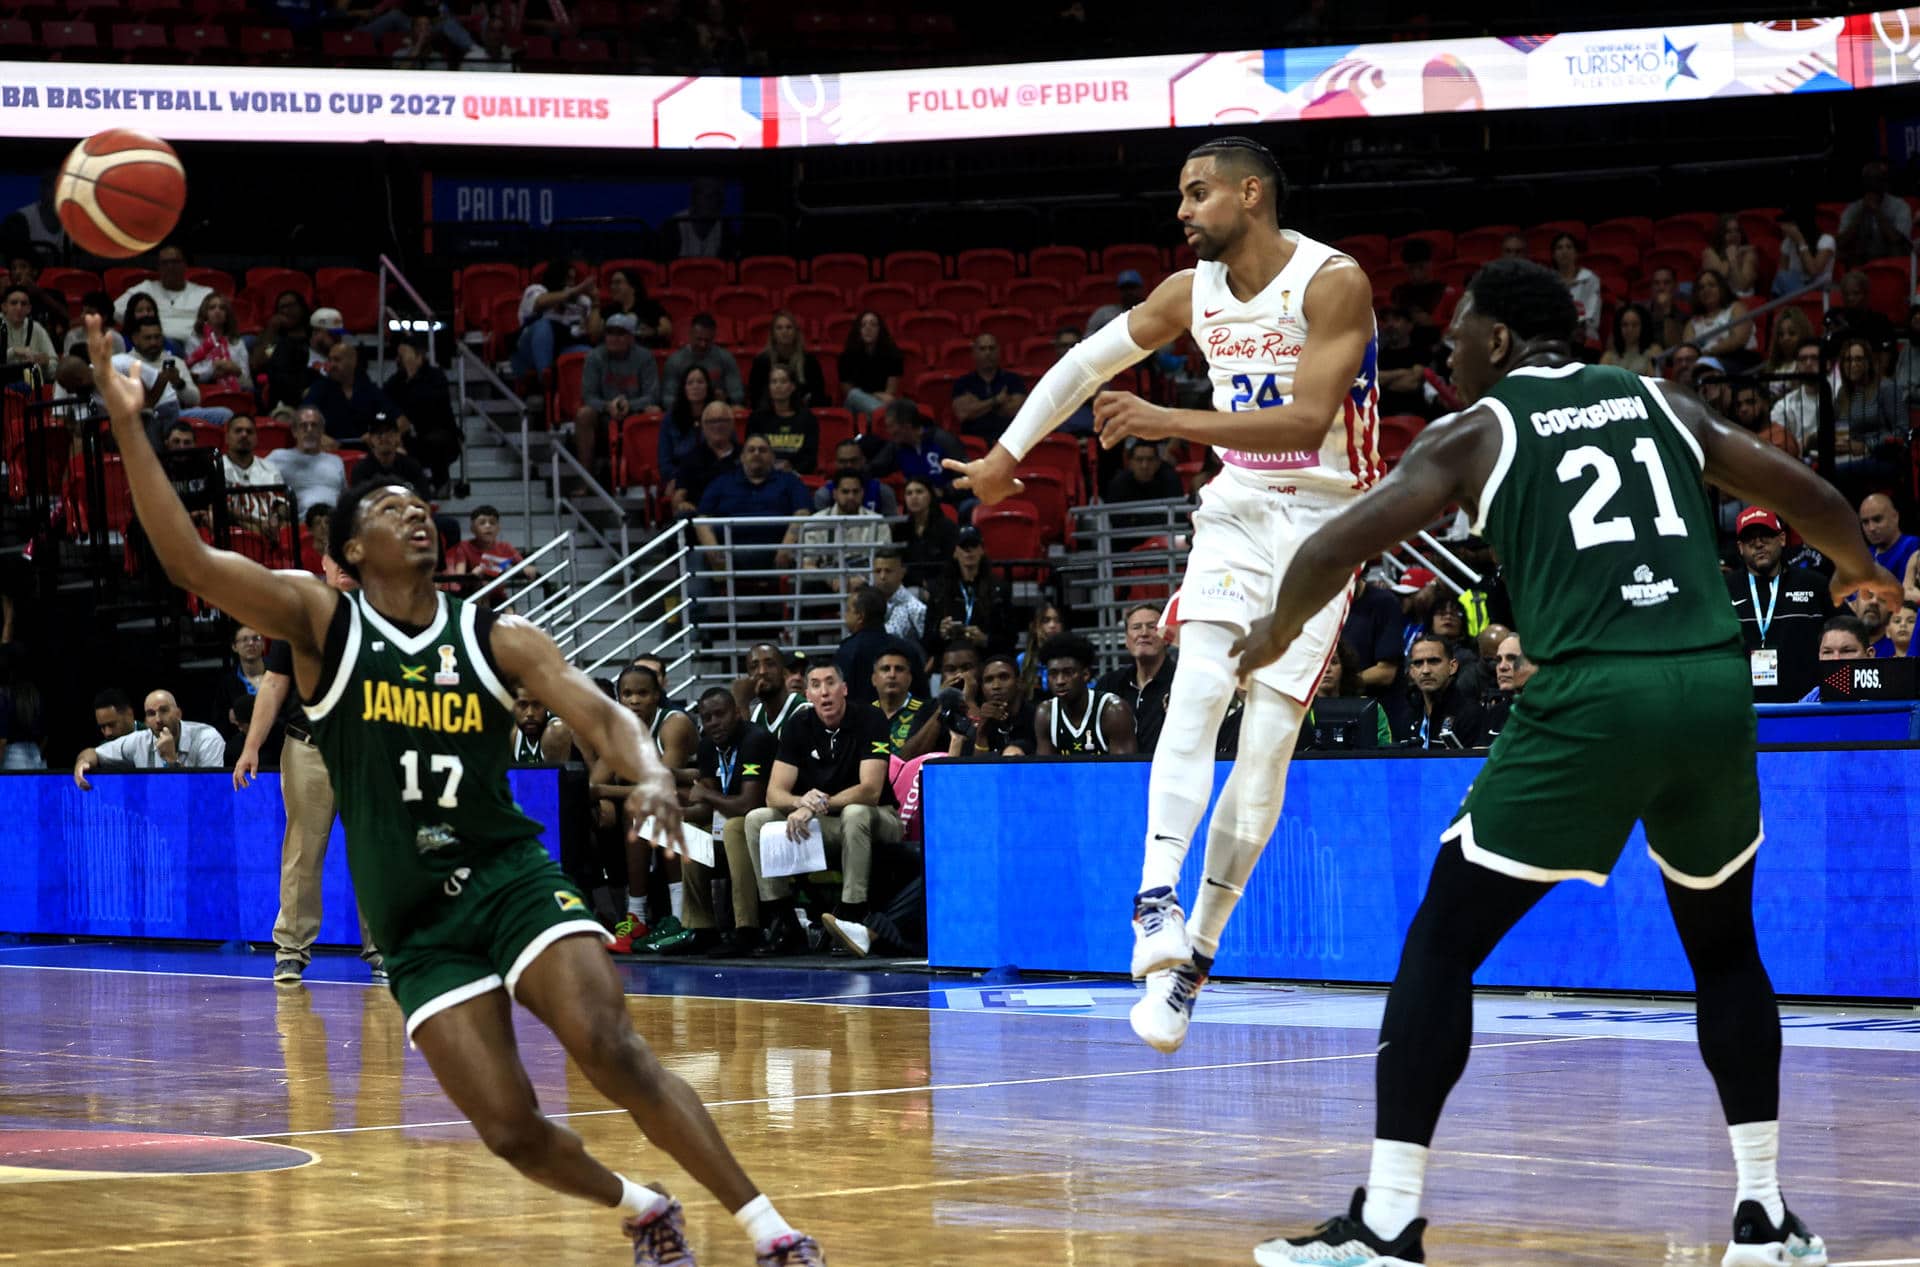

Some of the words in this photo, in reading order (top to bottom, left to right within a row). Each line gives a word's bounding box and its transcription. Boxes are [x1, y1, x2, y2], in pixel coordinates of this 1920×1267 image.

[1565, 52, 1660, 75] TURISMO
[46, 87, 222, 111] BASKETBALL
[230, 91, 321, 113] WORLD
[329, 93, 382, 115] CUP
[390, 95, 455, 116] 2027
[463, 96, 609, 120] QUALIFIERS
[908, 88, 1008, 112] FOLLOW
[1016, 80, 1129, 106] @FBPUR
[1208, 328, 1257, 360] Puerto
[1261, 333, 1302, 364] Rico
[1231, 374, 1284, 412] 24
[1530, 396, 1648, 437] COCKBURN
[1556, 437, 1688, 550] 21
[1854, 669, 1881, 688] POSS.
[362, 680, 483, 732] JAMAICA
[400, 750, 464, 808] 17
